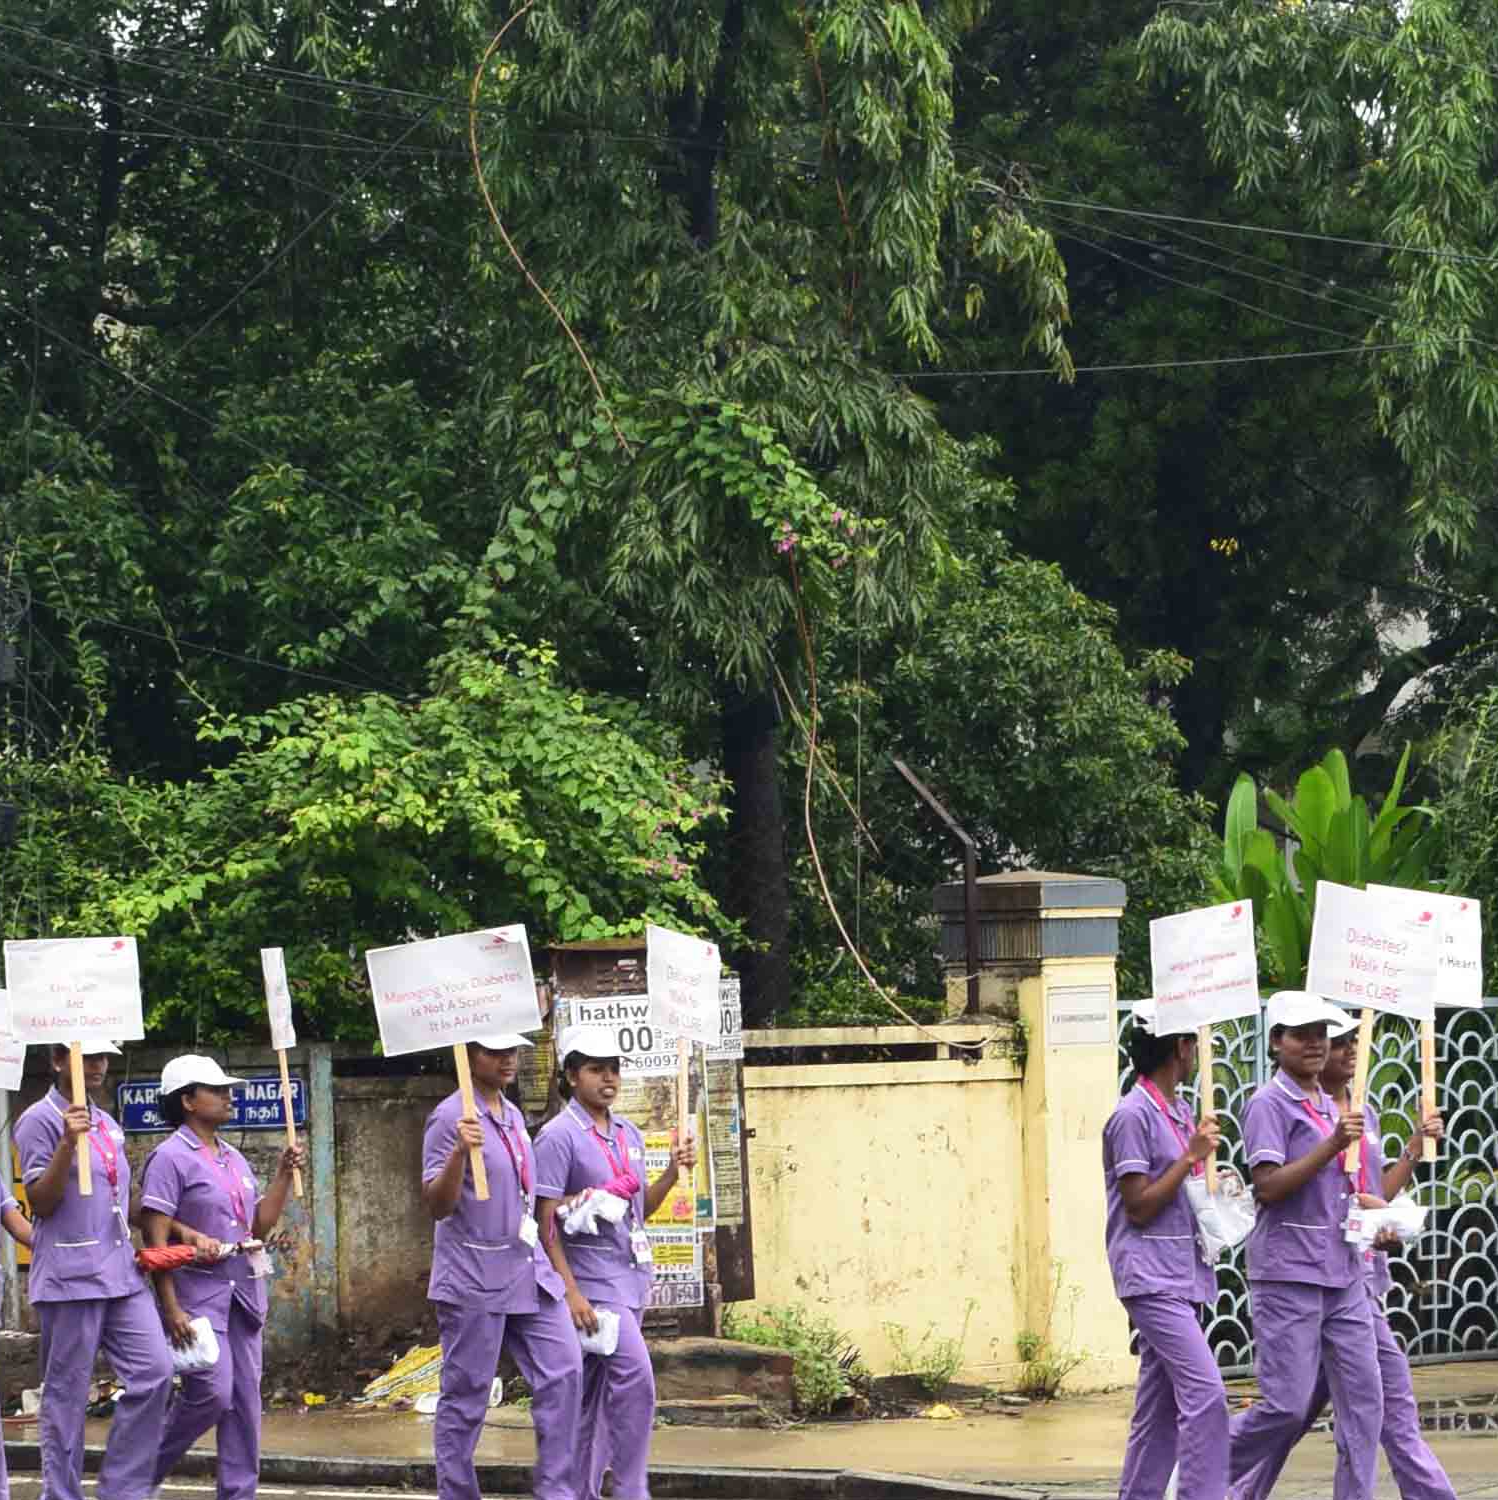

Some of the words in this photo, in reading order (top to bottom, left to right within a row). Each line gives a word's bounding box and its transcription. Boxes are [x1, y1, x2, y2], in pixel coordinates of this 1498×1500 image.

[1350, 953, 1379, 972] Walk
[580, 1003, 648, 1022] hathw
[245, 1083, 299, 1101] NAGAR
